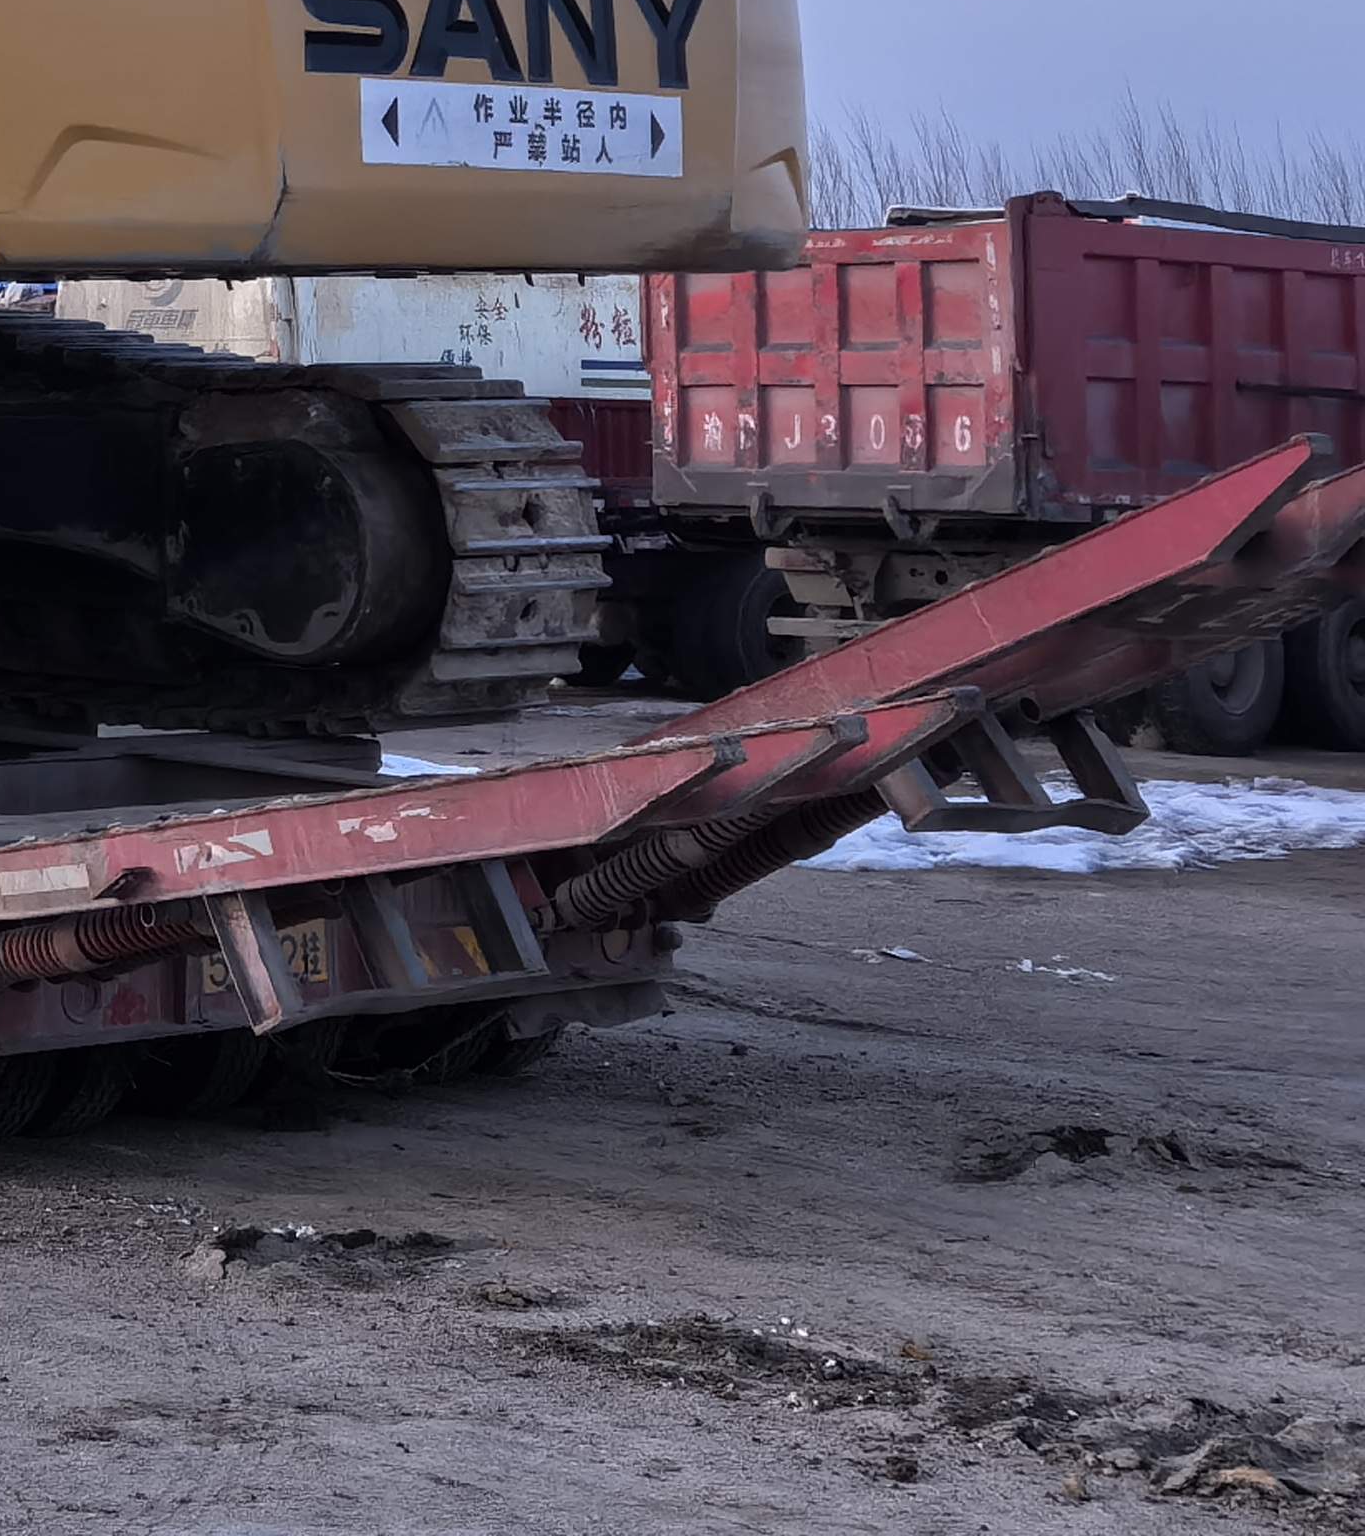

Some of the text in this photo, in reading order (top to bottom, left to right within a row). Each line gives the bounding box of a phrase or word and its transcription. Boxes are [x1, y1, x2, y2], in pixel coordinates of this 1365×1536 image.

[473, 93, 627, 130] 作业半径内
[492, 130, 613, 165] 严禁站人
